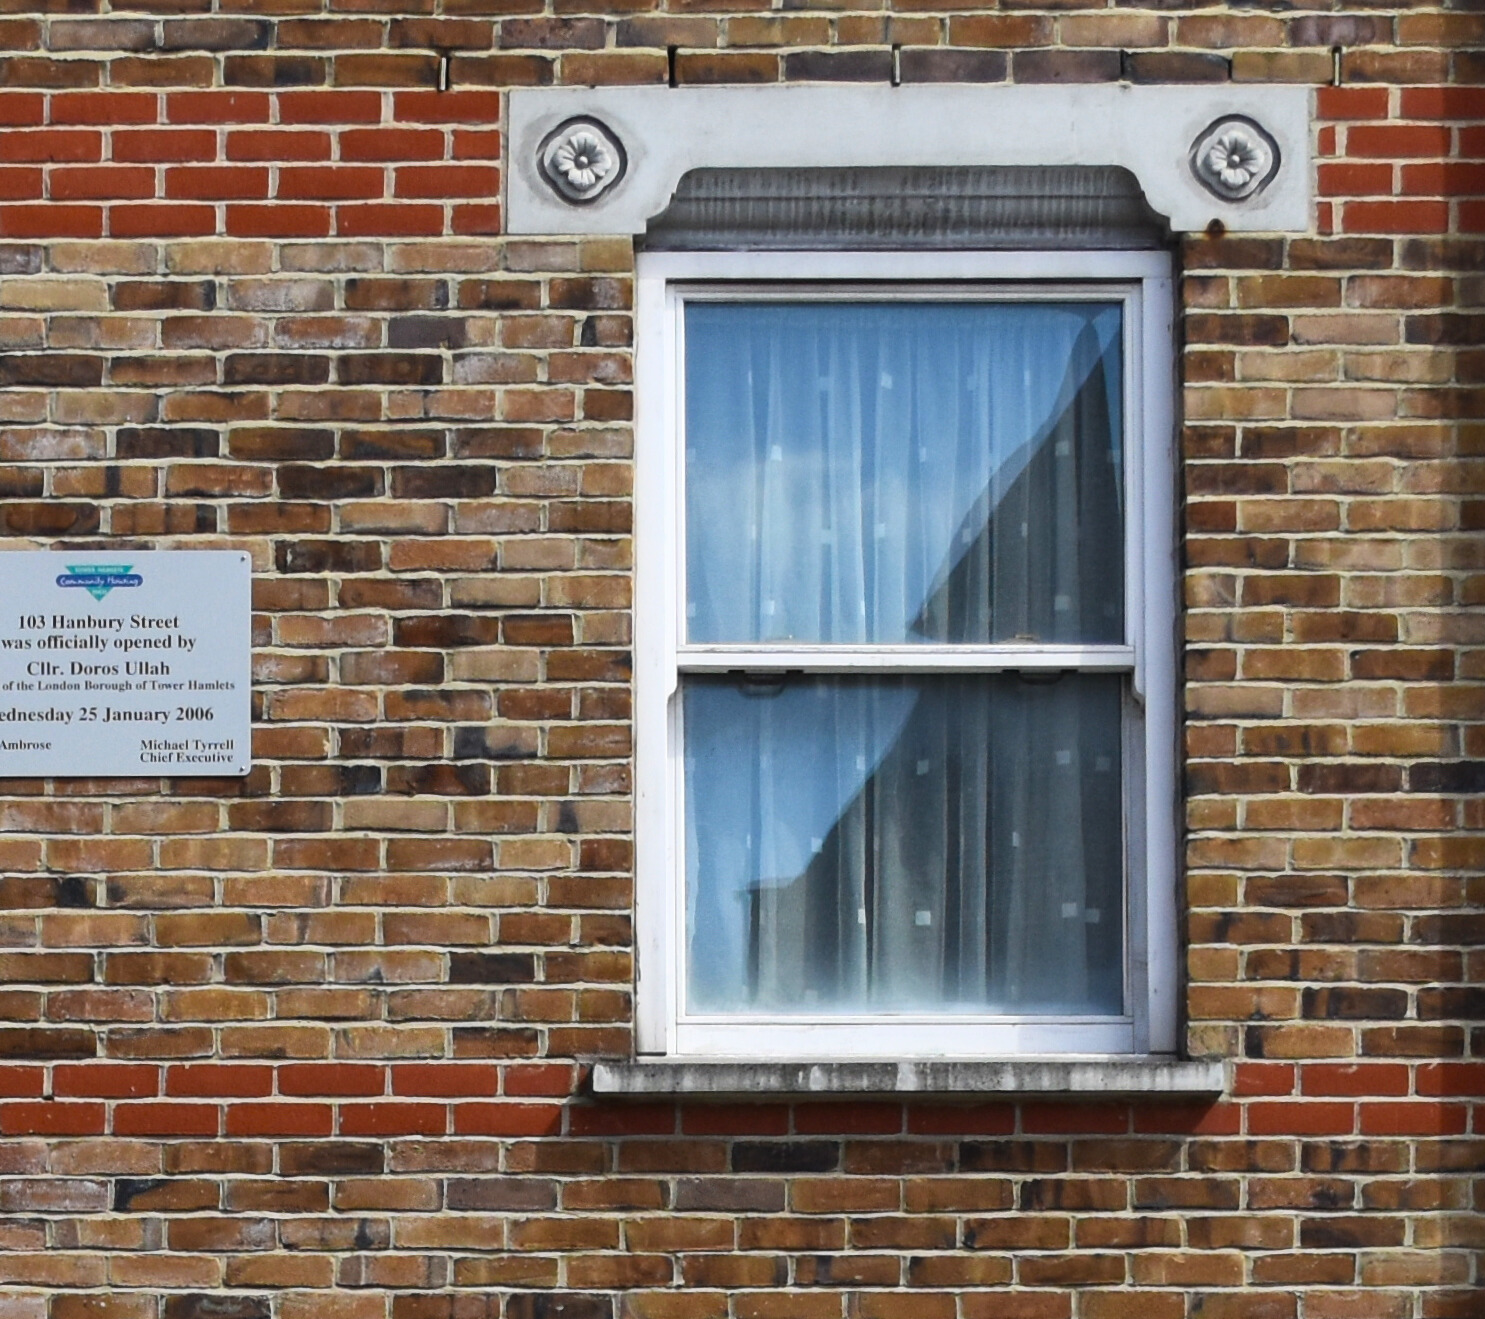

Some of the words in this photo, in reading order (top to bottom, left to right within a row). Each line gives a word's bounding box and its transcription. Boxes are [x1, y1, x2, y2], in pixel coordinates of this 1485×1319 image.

[60, 575, 105, 588] Community
[107, 575, 140, 588] Housing
[18, 614, 46, 630] 103
[52, 614, 125, 632] Hanbury
[130, 614, 180, 630] Street
[1, 639, 32, 650] was
[37, 634, 109, 653] officially
[113, 634, 172, 653] opened
[177, 634, 197, 653] by
[26, 661, 65, 676] Cllr.
[70, 661, 119, 676] Doros
[125, 661, 171, 676] Ullah
[2, 681, 15, 691] of
[17, 680, 34, 691] the
[37, 680, 81, 691] London
[84, 680, 132, 693] Borough
[135, 680, 148, 690] of
[150, 680, 185, 691] Tower
[188, 680, 236, 691] Hamlets
[78, 706, 98, 722] 25
[102, 706, 171, 725] January
[175, 706, 215, 722] 2006
[140, 739, 189, 751] Michael
[193, 739, 235, 753] Tyrrell
[139, 751, 174, 763] Chief
[176, 751, 235, 763] Executive
